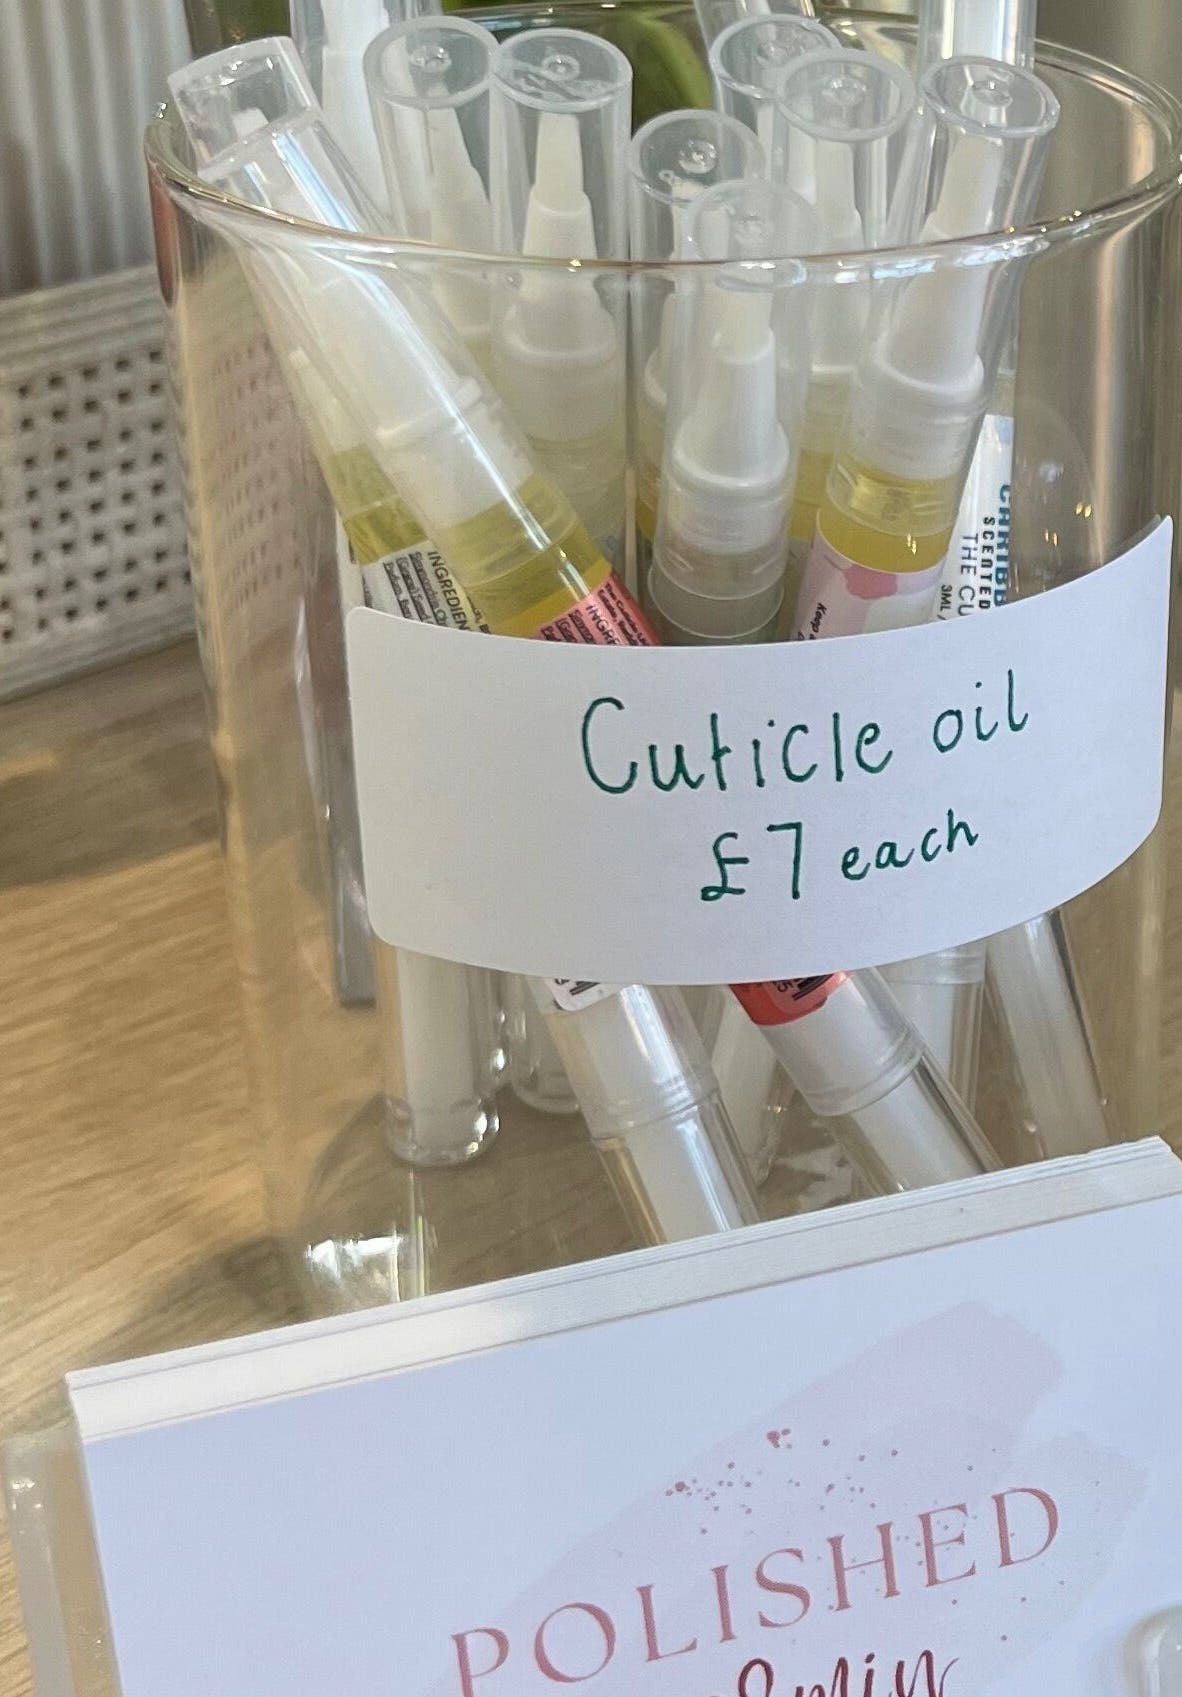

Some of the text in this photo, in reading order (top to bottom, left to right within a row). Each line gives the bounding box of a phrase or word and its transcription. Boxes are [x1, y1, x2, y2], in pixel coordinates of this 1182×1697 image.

[960, 533, 979, 577] THE
[978, 516, 996, 610] SCENTED
[580, 668, 1029, 795] Cuticle oil
[699, 808, 979, 902] £7 each
[450, 1485, 1060, 1697] POLISHED
